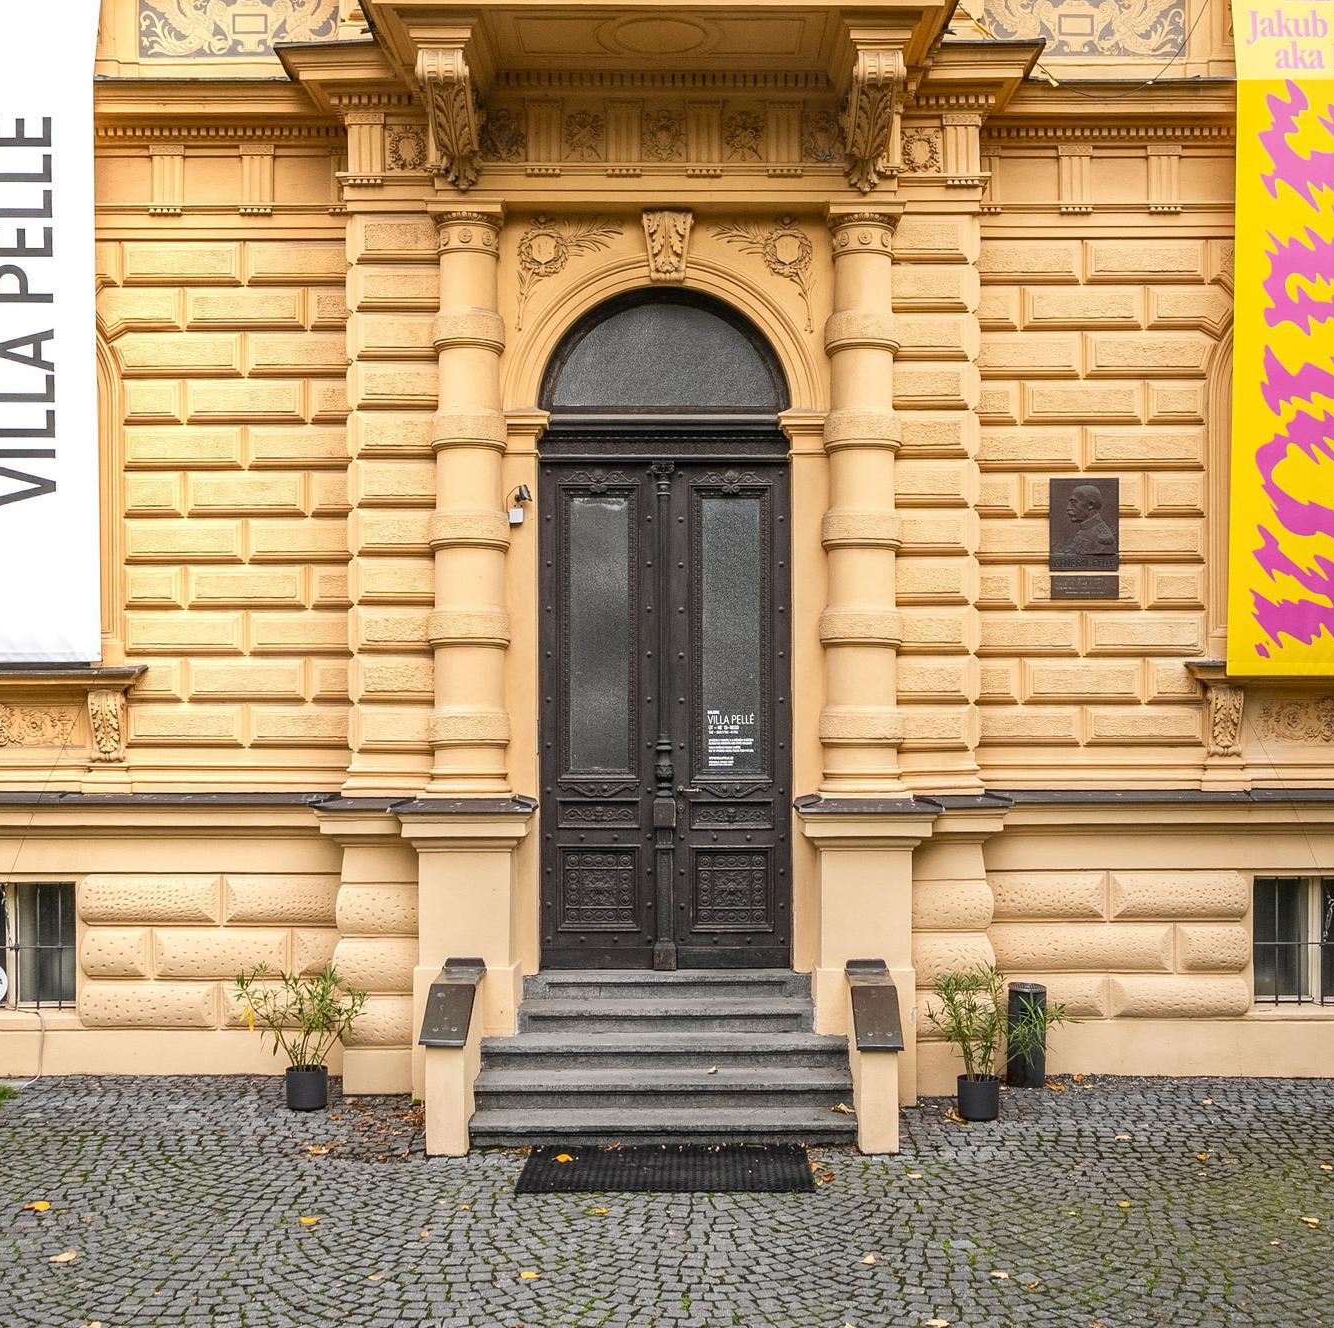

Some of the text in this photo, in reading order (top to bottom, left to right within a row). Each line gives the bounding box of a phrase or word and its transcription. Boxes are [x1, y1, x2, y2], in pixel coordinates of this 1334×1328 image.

[1246, 8, 1329, 45] Jakub
[1275, 42, 1325, 70] aka
[707, 714, 730, 725] VILLA
[731, 712, 755, 725] PELLÉ
